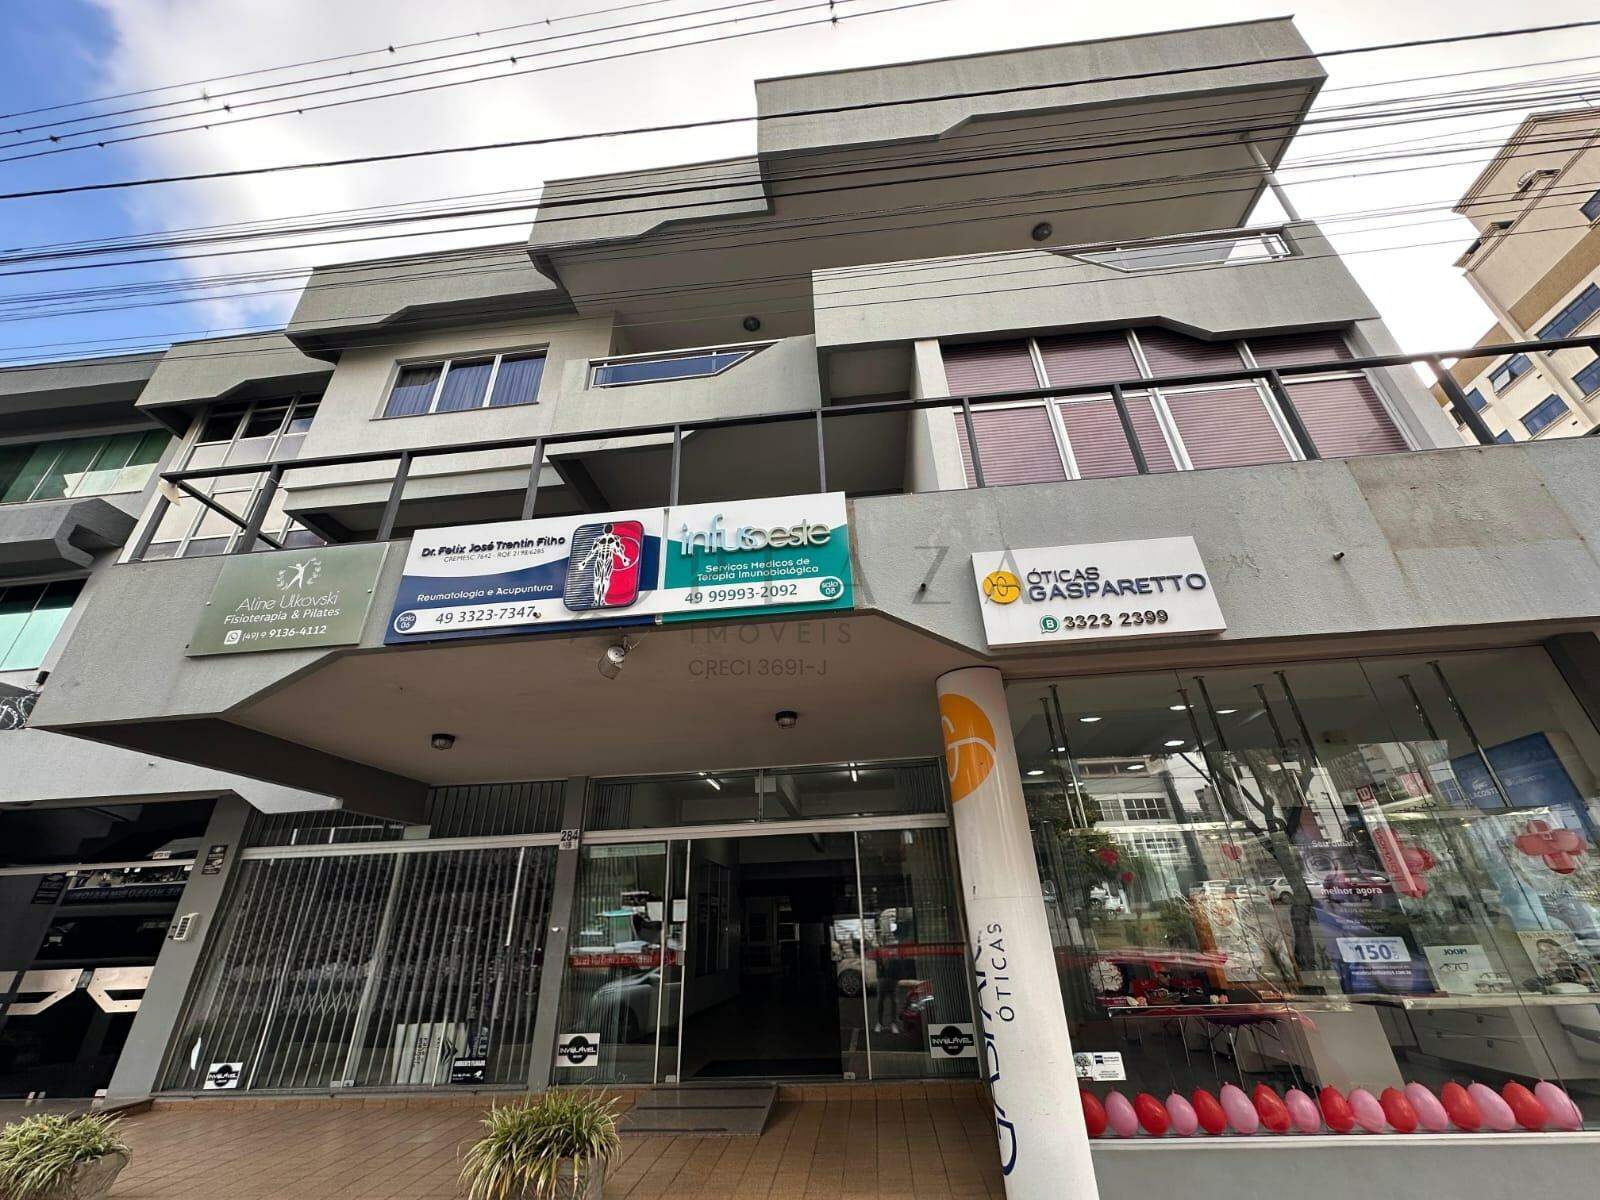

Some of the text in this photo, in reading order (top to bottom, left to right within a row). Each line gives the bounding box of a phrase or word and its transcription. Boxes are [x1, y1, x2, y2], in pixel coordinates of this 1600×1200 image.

[421, 536, 566, 558] Dr. Felix José Trentin Filho
[796, 558, 810, 566] de
[697, 566, 819, 582] Terapia Imunobiológica
[1026, 567, 1101, 585] ÓTICAS
[417, 584, 554, 602] Reumatologia e Acupuntura
[685, 584, 798, 604] 49 99993-2092
[1028, 573, 1207, 602] GASPARETTO
[235, 596, 276, 612] Aline
[223, 608, 340, 625] Fisioterapia & Pilates
[435, 606, 536, 625] 49 3323-7347
[1063, 609, 1169, 630] 3323 2399
[242, 625, 328, 642] (49) 9 9136-4112
[561, 829, 578, 842] 284
[1320, 886, 1384, 897] melhor agora
[1354, 944, 1392, 961] 150
[986, 922, 1016, 1023] ÓTICAS
